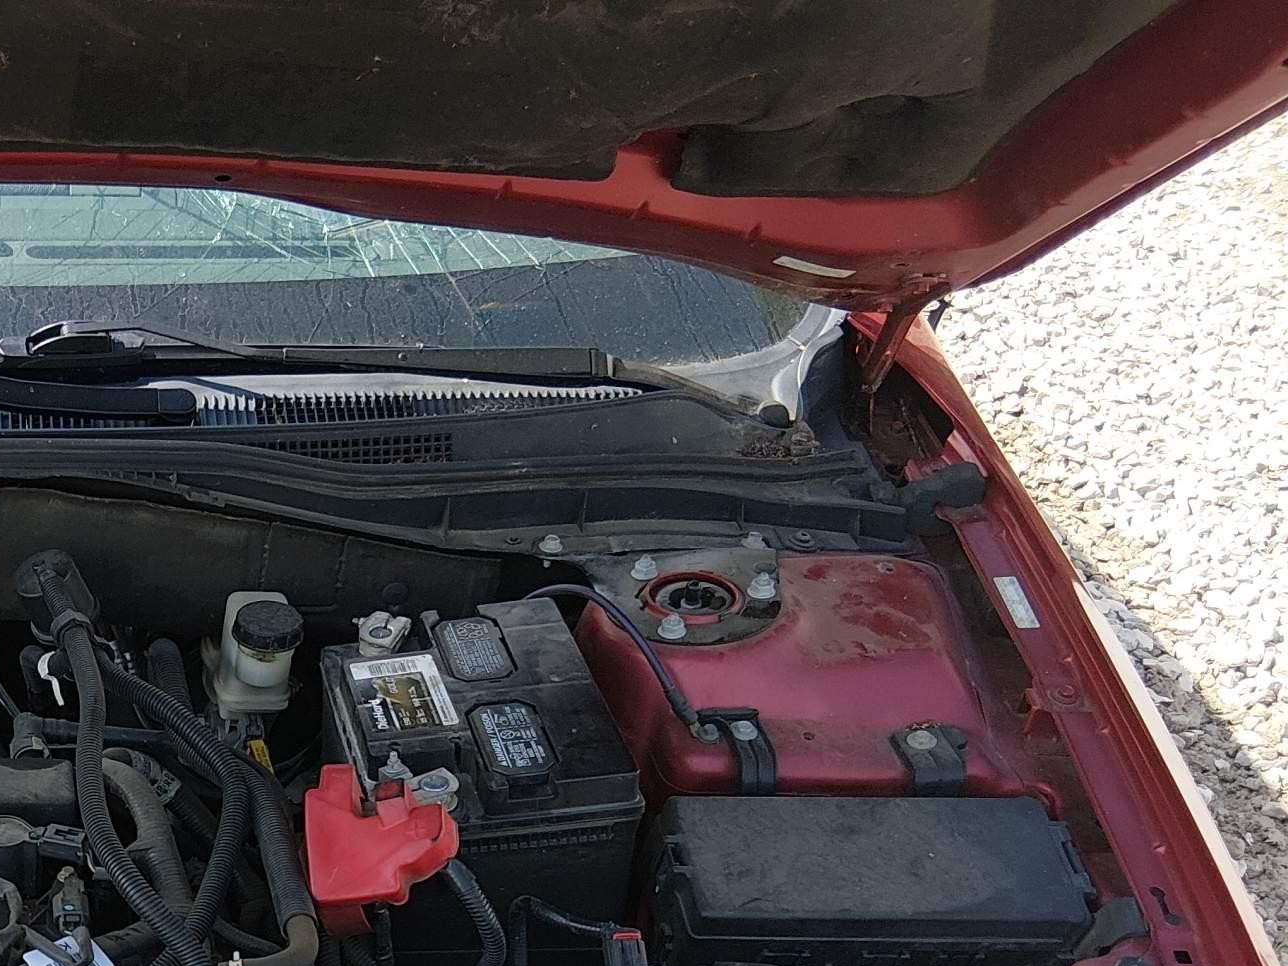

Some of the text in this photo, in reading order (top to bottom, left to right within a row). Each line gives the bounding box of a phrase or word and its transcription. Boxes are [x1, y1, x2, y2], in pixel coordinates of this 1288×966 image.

[368, 699, 389, 730] DieHard
[479, 713, 493, 733] POISON
[488, 737, 507, 763] DANGER
